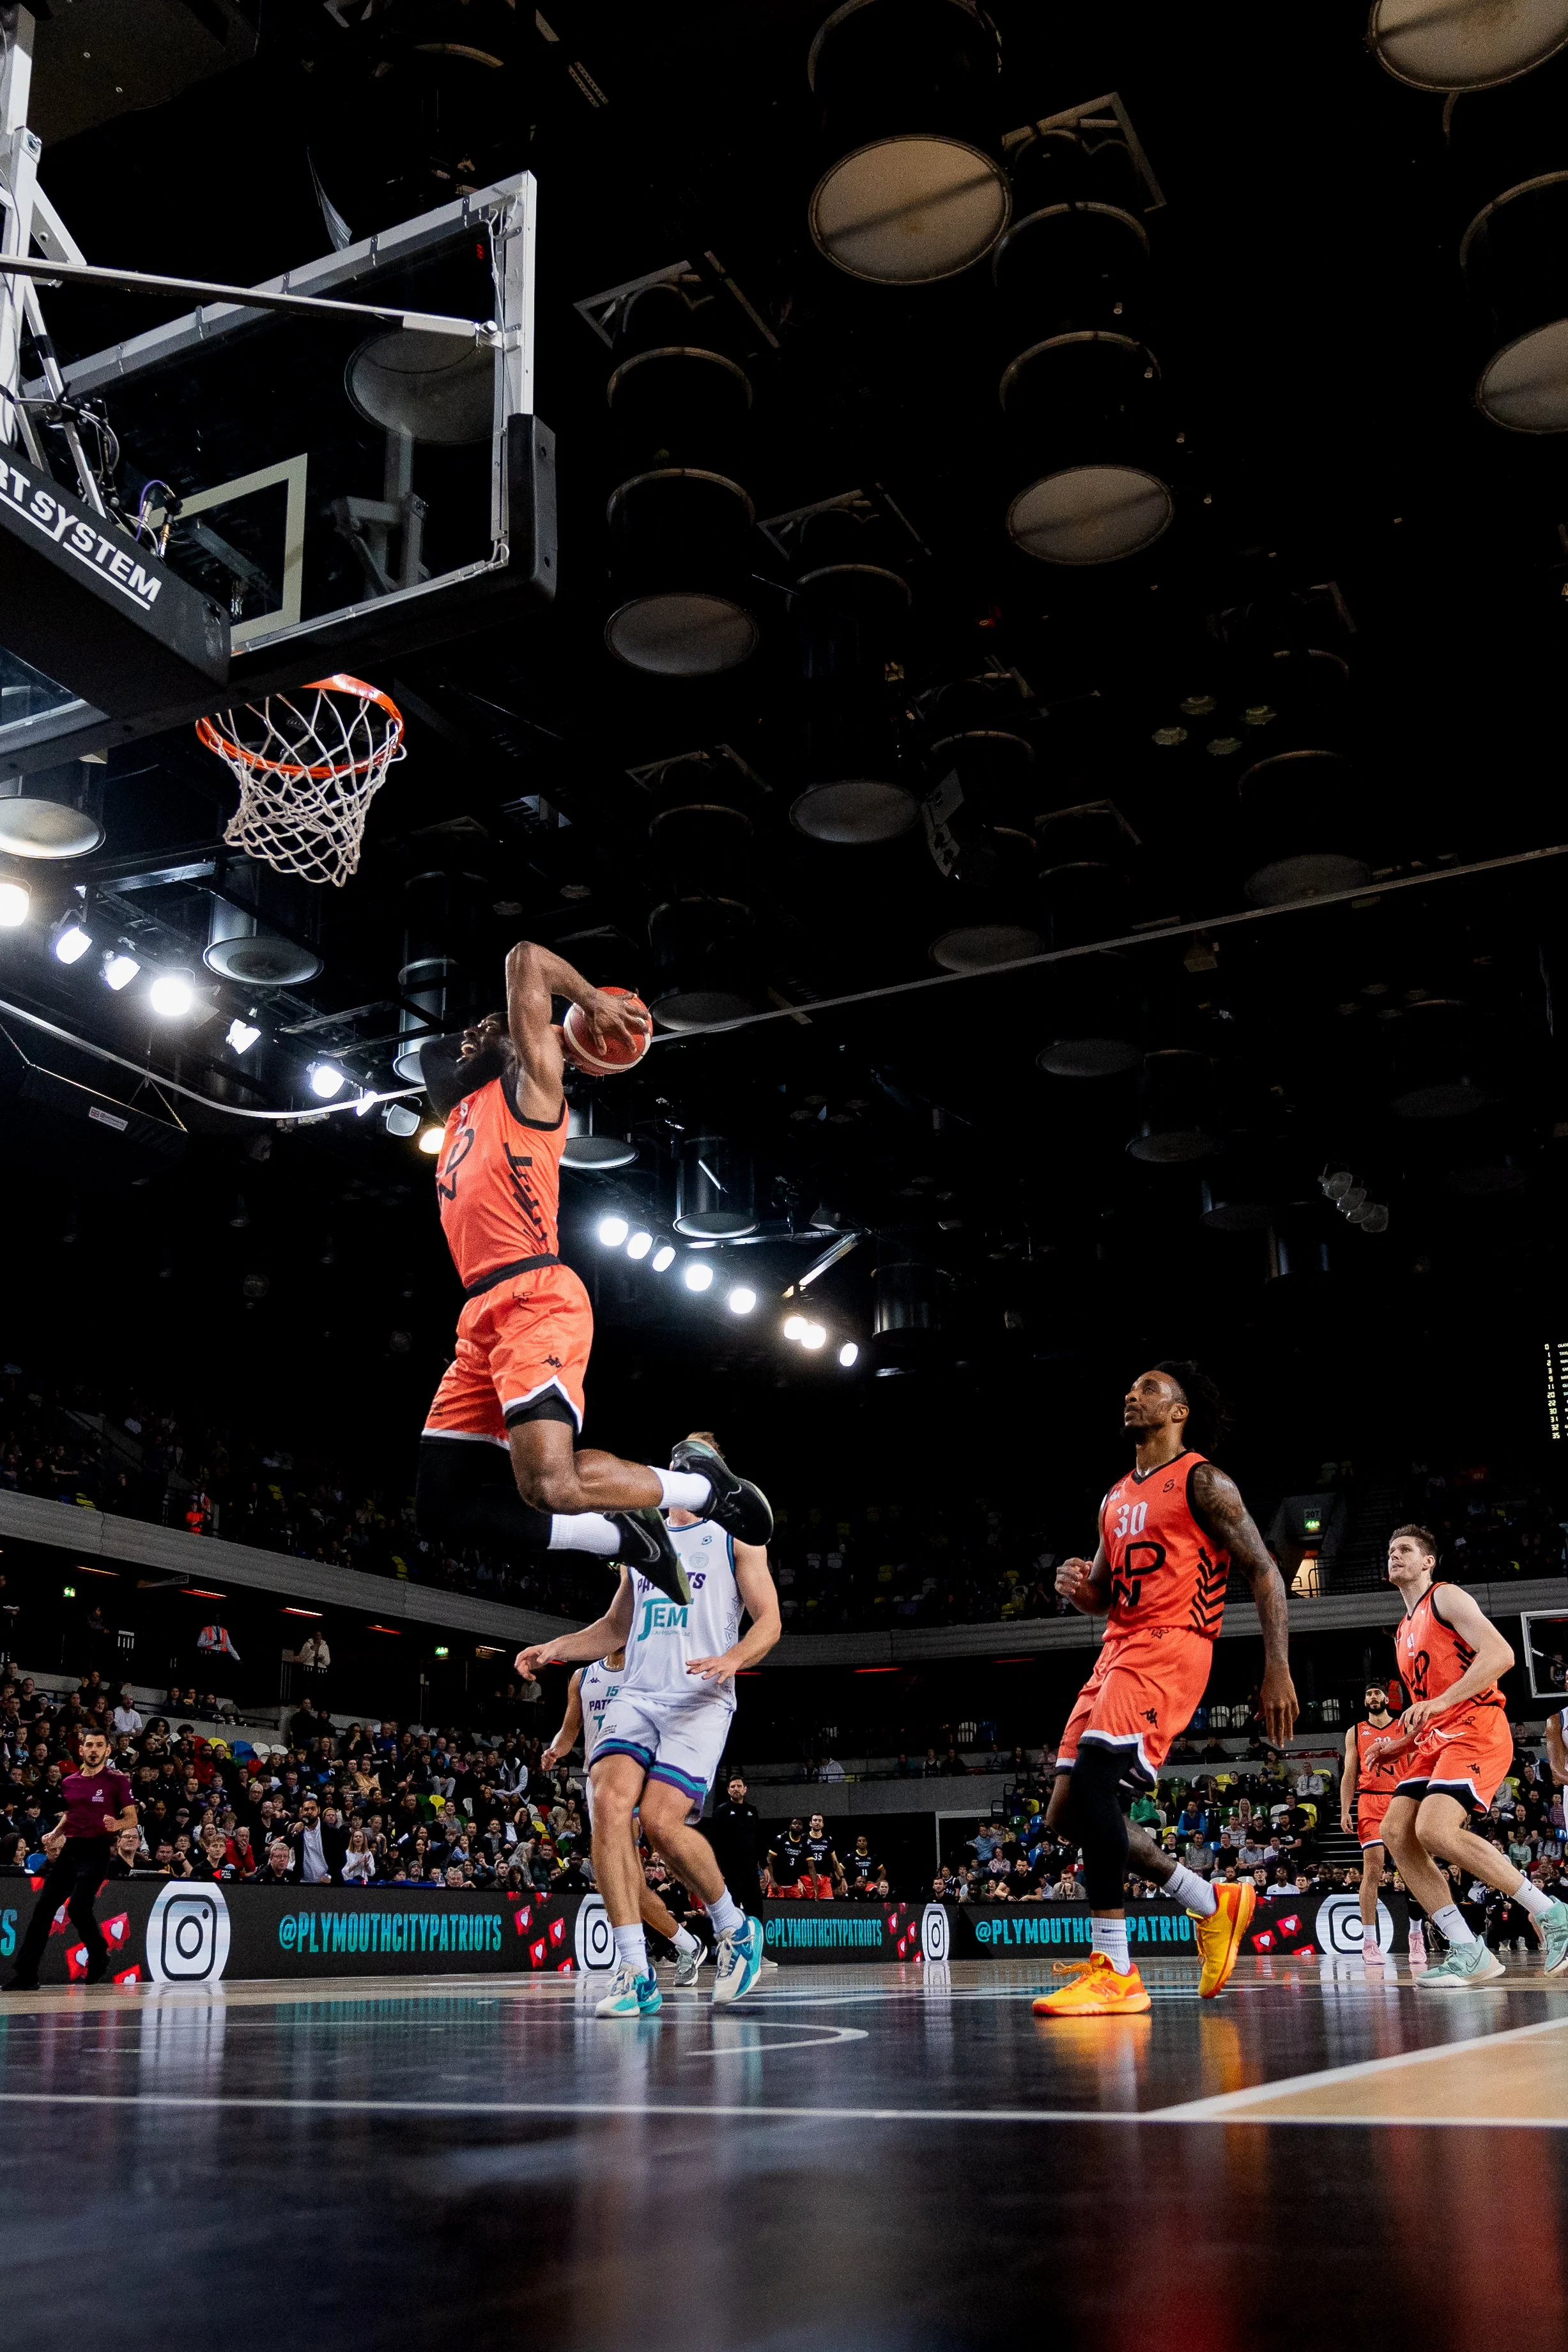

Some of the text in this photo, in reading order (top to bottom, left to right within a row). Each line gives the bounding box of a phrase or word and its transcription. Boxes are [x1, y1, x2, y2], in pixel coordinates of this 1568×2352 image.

[30, 491, 162, 603] SYSTEM
[1114, 1501, 1148, 1538] 30
[1305, 1510, 1320, 1518] 207
[638, 1597, 694, 1641] JEM
[606, 1686, 619, 1697] 15
[789, 1857, 795, 1866] 3
[813, 1853, 822, 1861] 35
[279, 1912, 502, 1953] @PLYMOUTHCITYPATRIOTS
[765, 1918, 882, 1947] @PLYMOUTHCITYPATRIOTS
